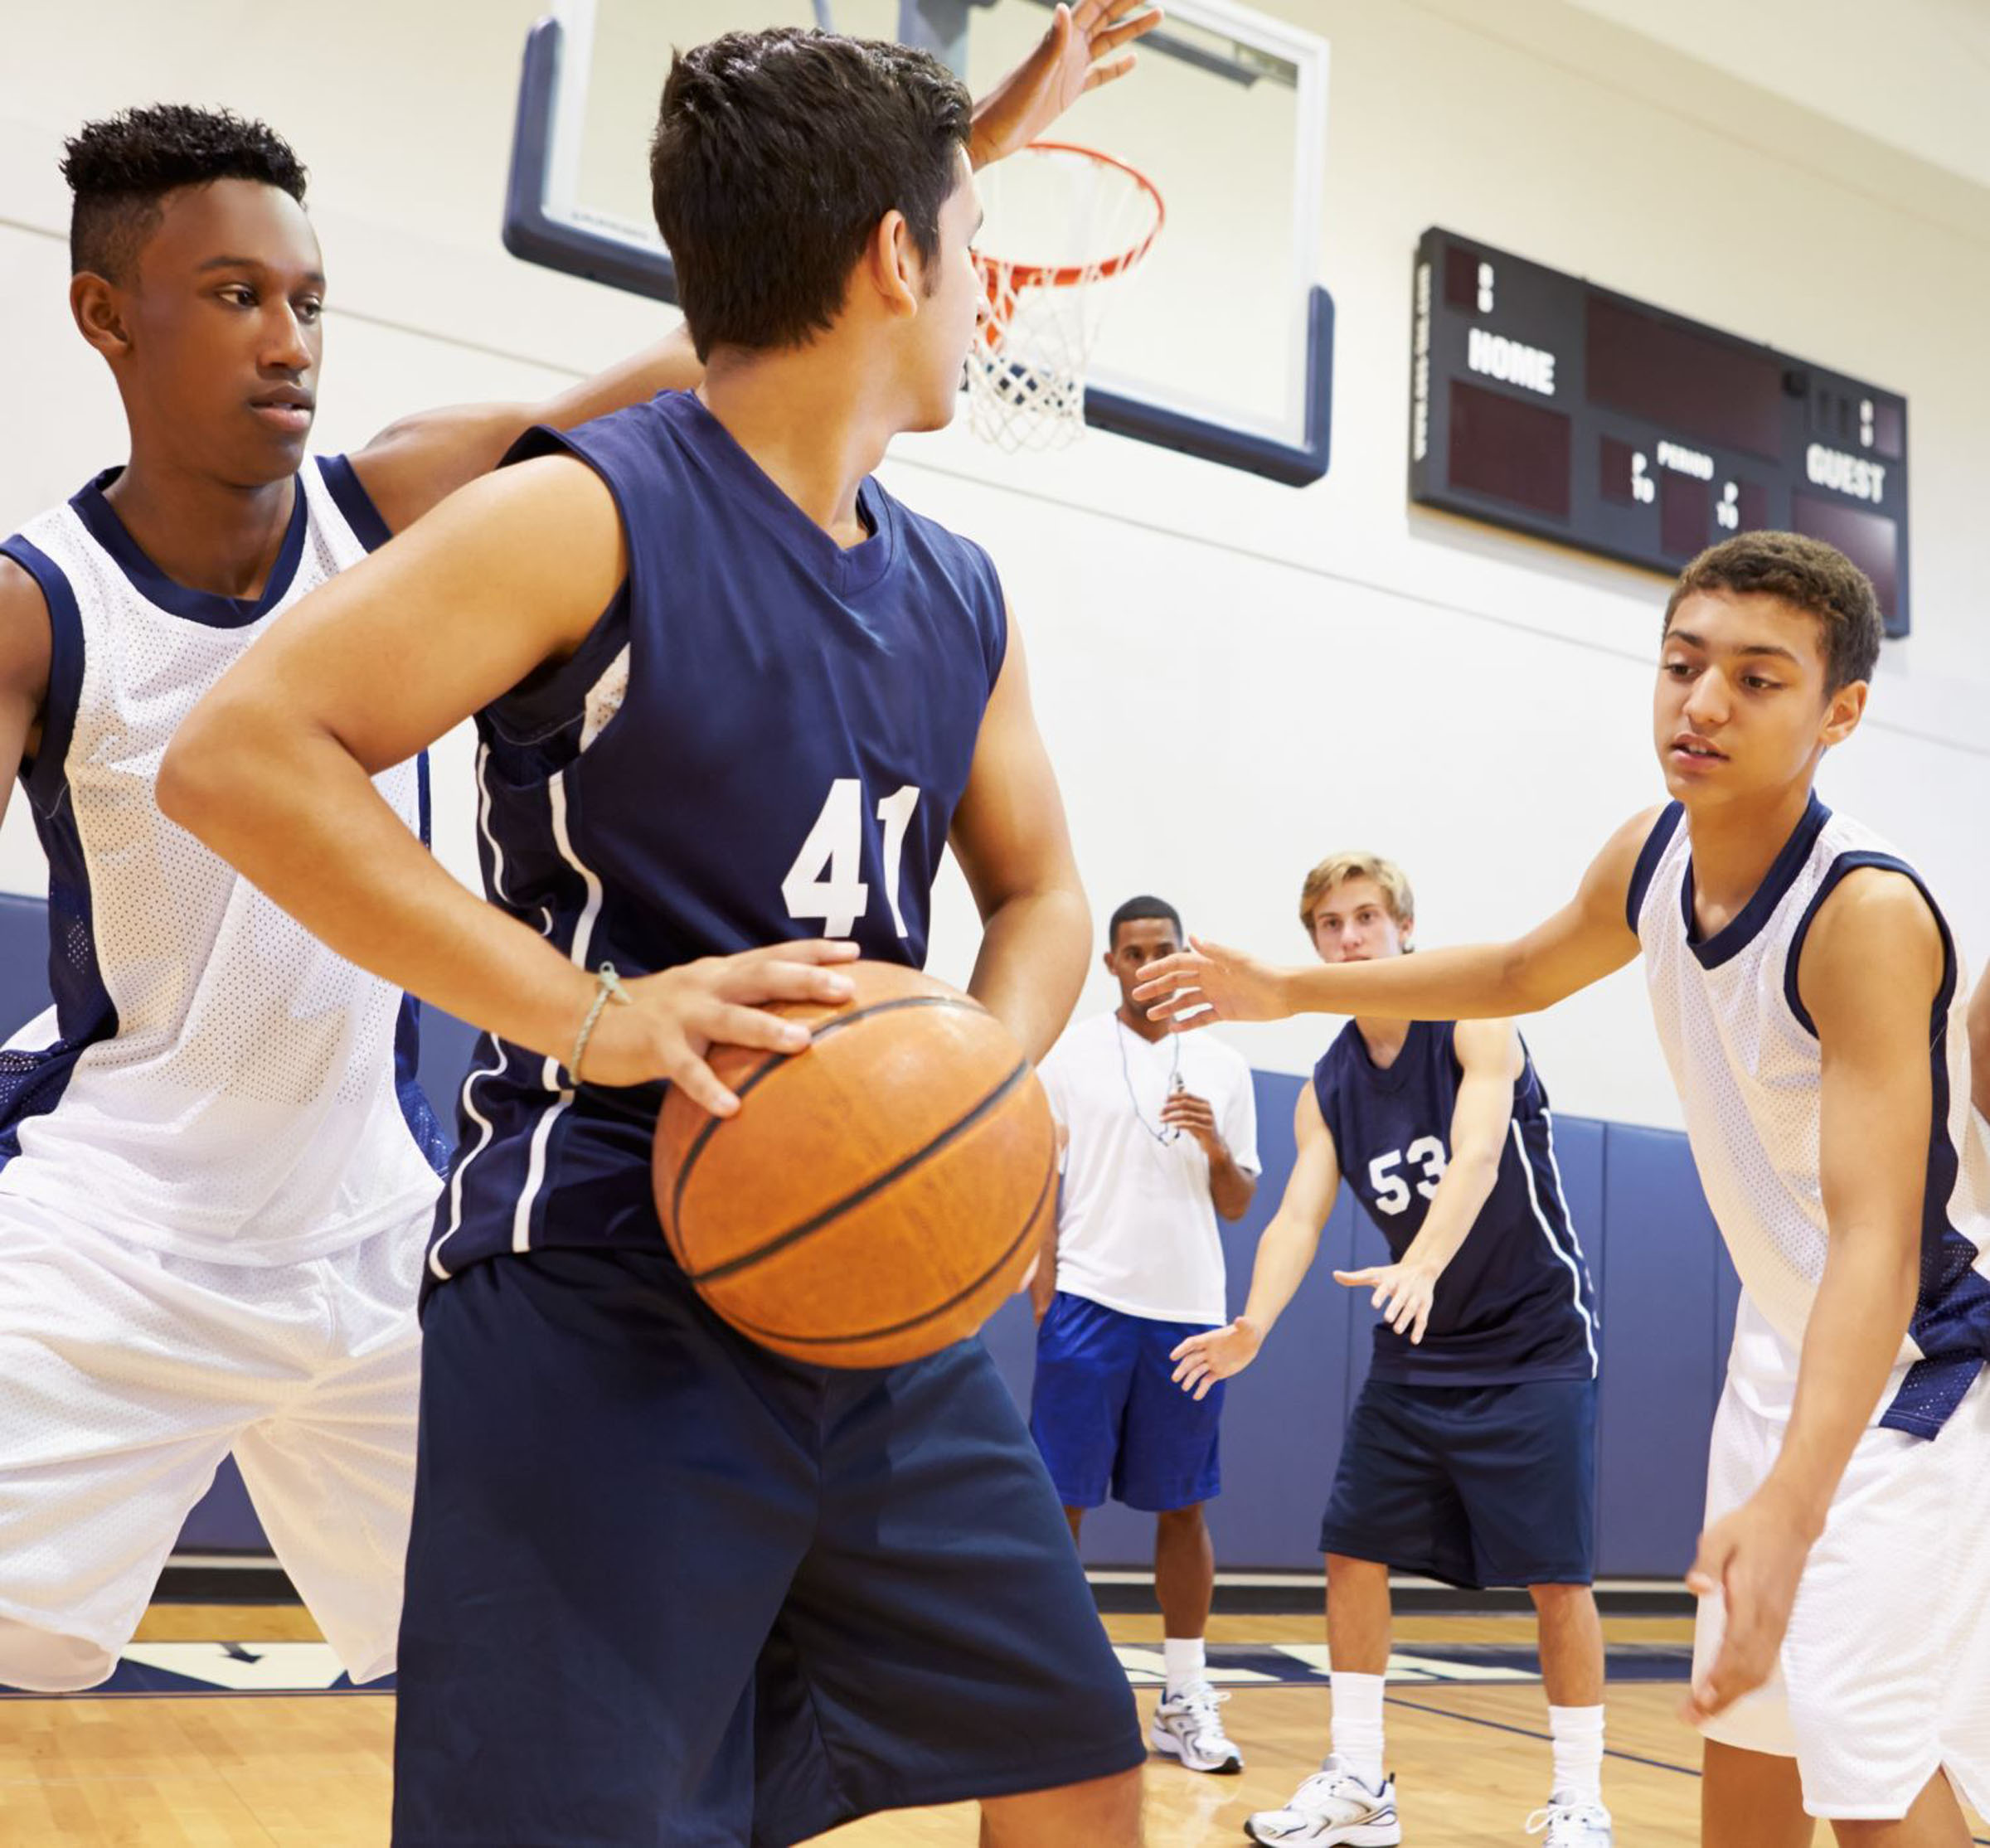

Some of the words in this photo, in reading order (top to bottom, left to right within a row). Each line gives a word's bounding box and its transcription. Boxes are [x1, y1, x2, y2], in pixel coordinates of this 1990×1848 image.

[1468, 327, 1556, 395] HOME
[1807, 443, 1886, 504] GUEST
[781, 778, 920, 938] 41
[1368, 1135, 1447, 1215] 53
